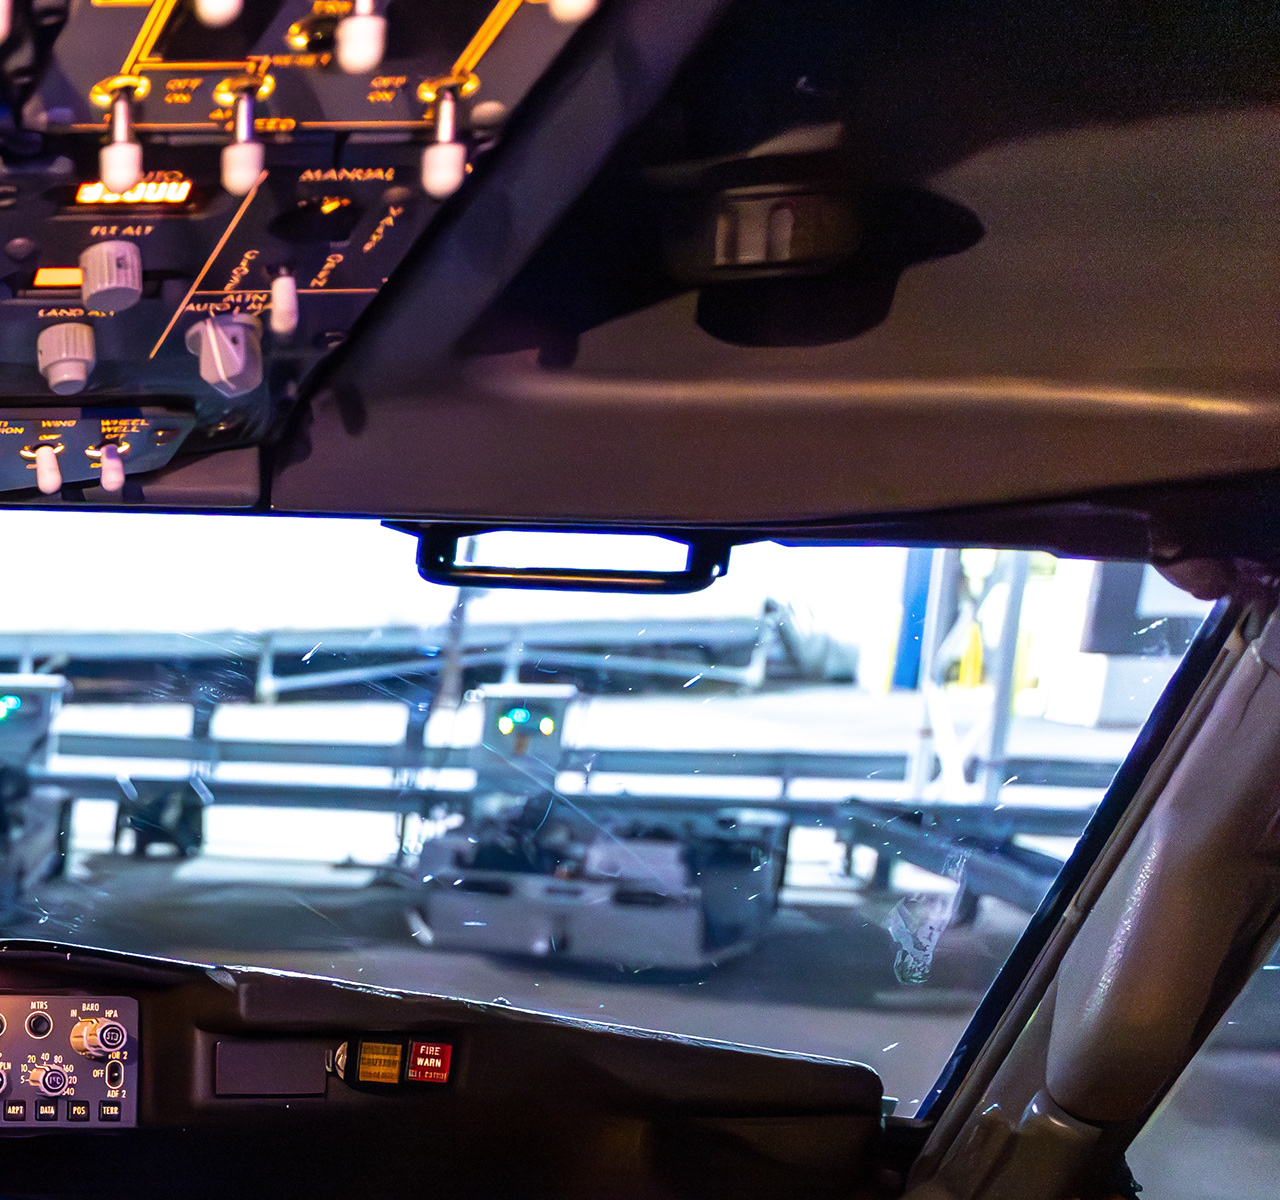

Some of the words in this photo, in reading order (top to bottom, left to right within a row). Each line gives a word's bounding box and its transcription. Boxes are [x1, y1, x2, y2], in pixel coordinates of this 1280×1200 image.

[82, 1003, 99, 1011] BARO
[105, 1010, 118, 1018] HPA
[421, 1046, 441, 1055] FIRE
[417, 1057, 441, 1068] WARN
